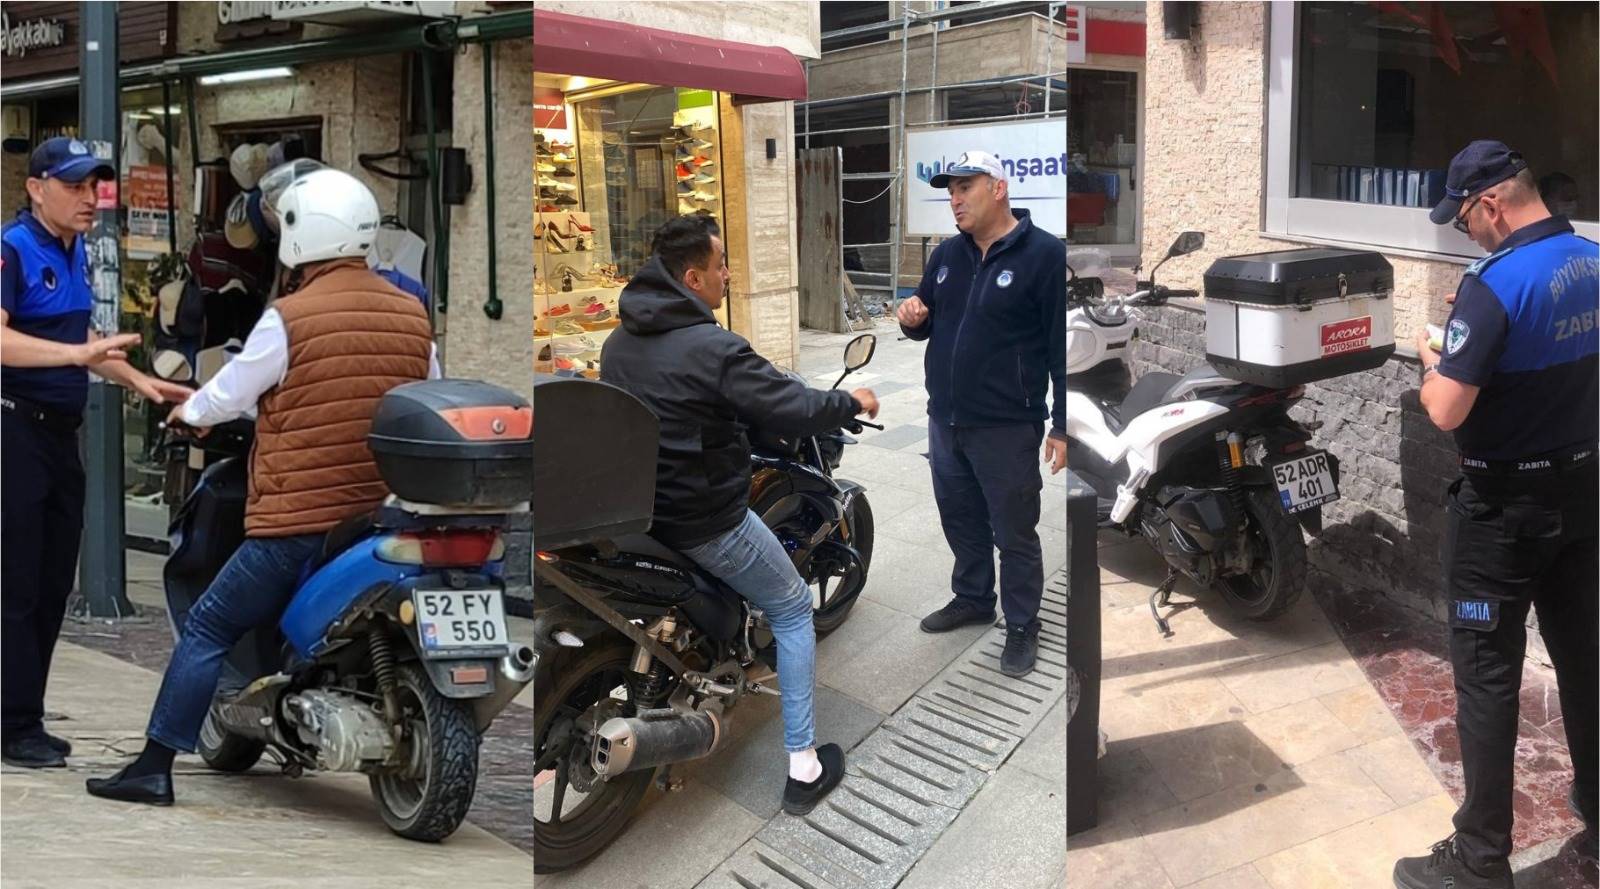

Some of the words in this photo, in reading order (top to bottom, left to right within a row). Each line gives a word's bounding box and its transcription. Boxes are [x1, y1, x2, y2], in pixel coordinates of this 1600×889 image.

[994, 152, 1067, 183] nşaat
[1326, 325, 1368, 343] ARORA
[1274, 463, 1297, 485] 52
[1297, 455, 1328, 480] ADR
[1298, 477, 1323, 499] 401
[424, 594, 454, 616] 52
[462, 594, 491, 615] FY
[451, 620, 496, 641] 550
